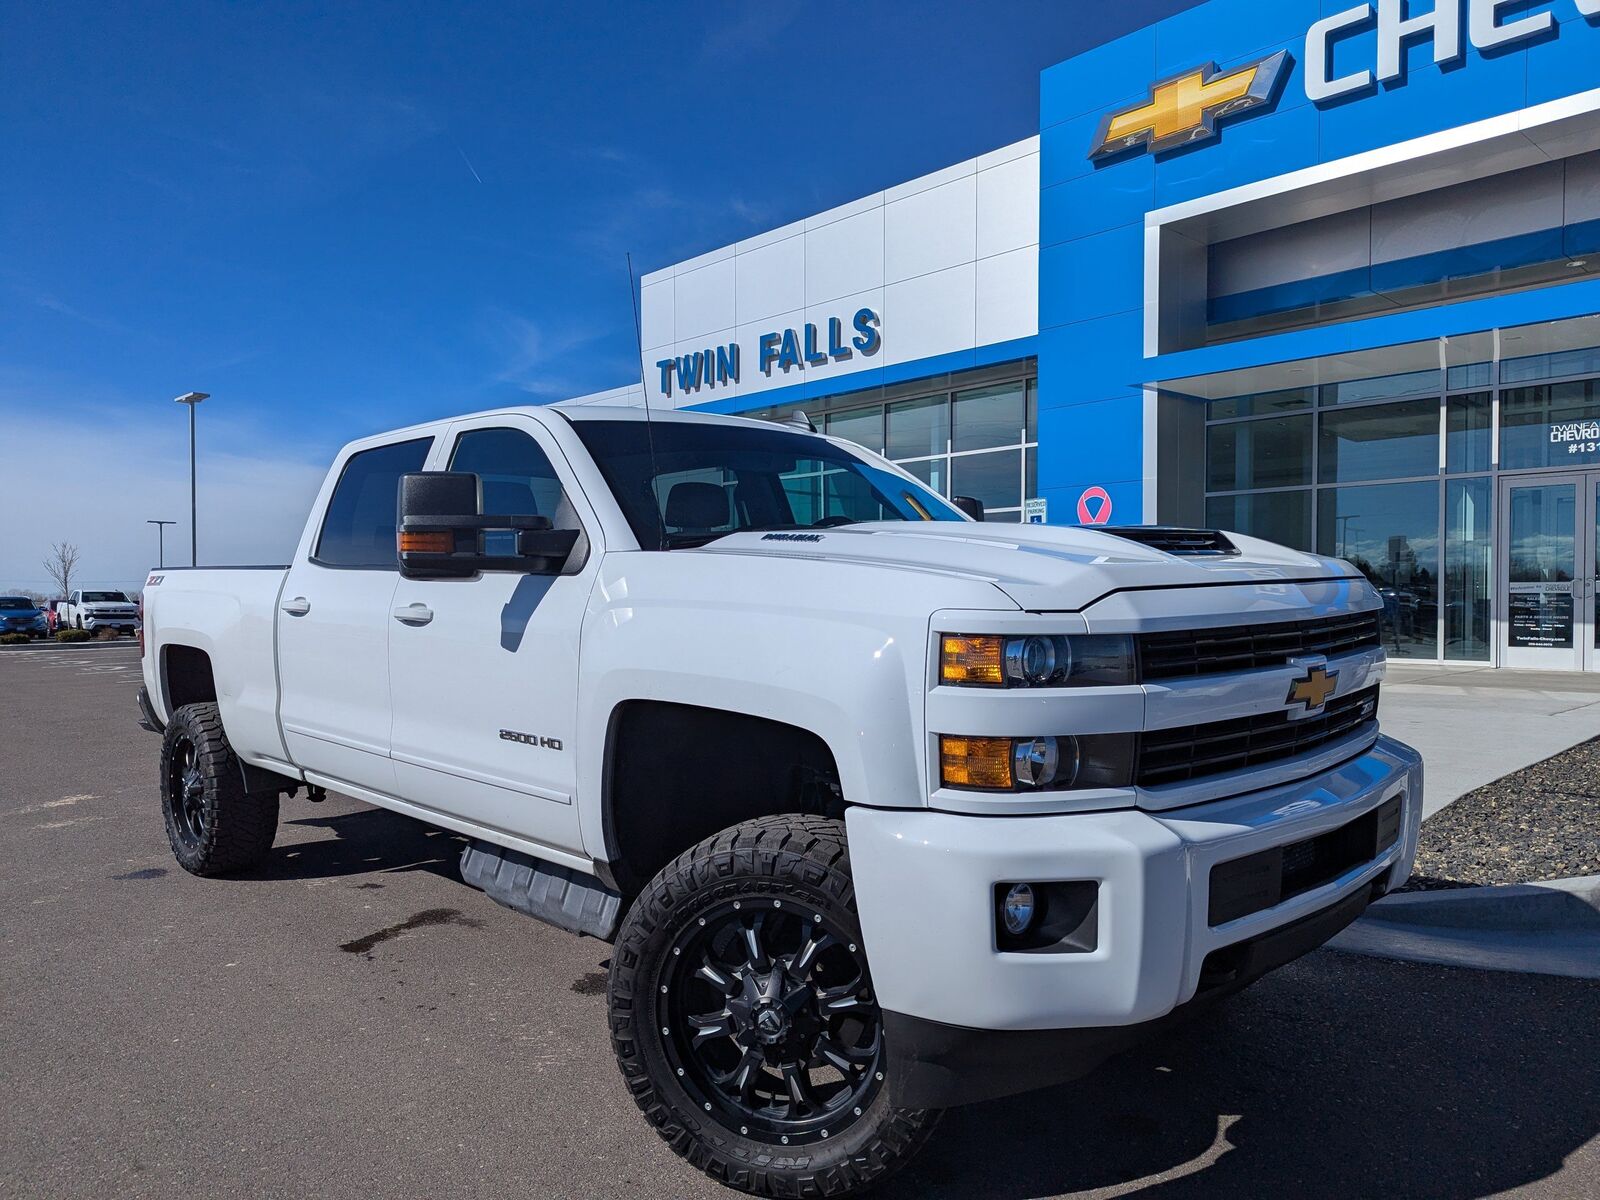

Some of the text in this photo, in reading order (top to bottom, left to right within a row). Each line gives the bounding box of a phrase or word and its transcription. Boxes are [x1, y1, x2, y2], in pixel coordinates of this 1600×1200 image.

[1304, 0, 1600, 101] CHE
[656, 307, 881, 398] TWIN FALLS
[499, 728, 563, 751] 2500 HD
